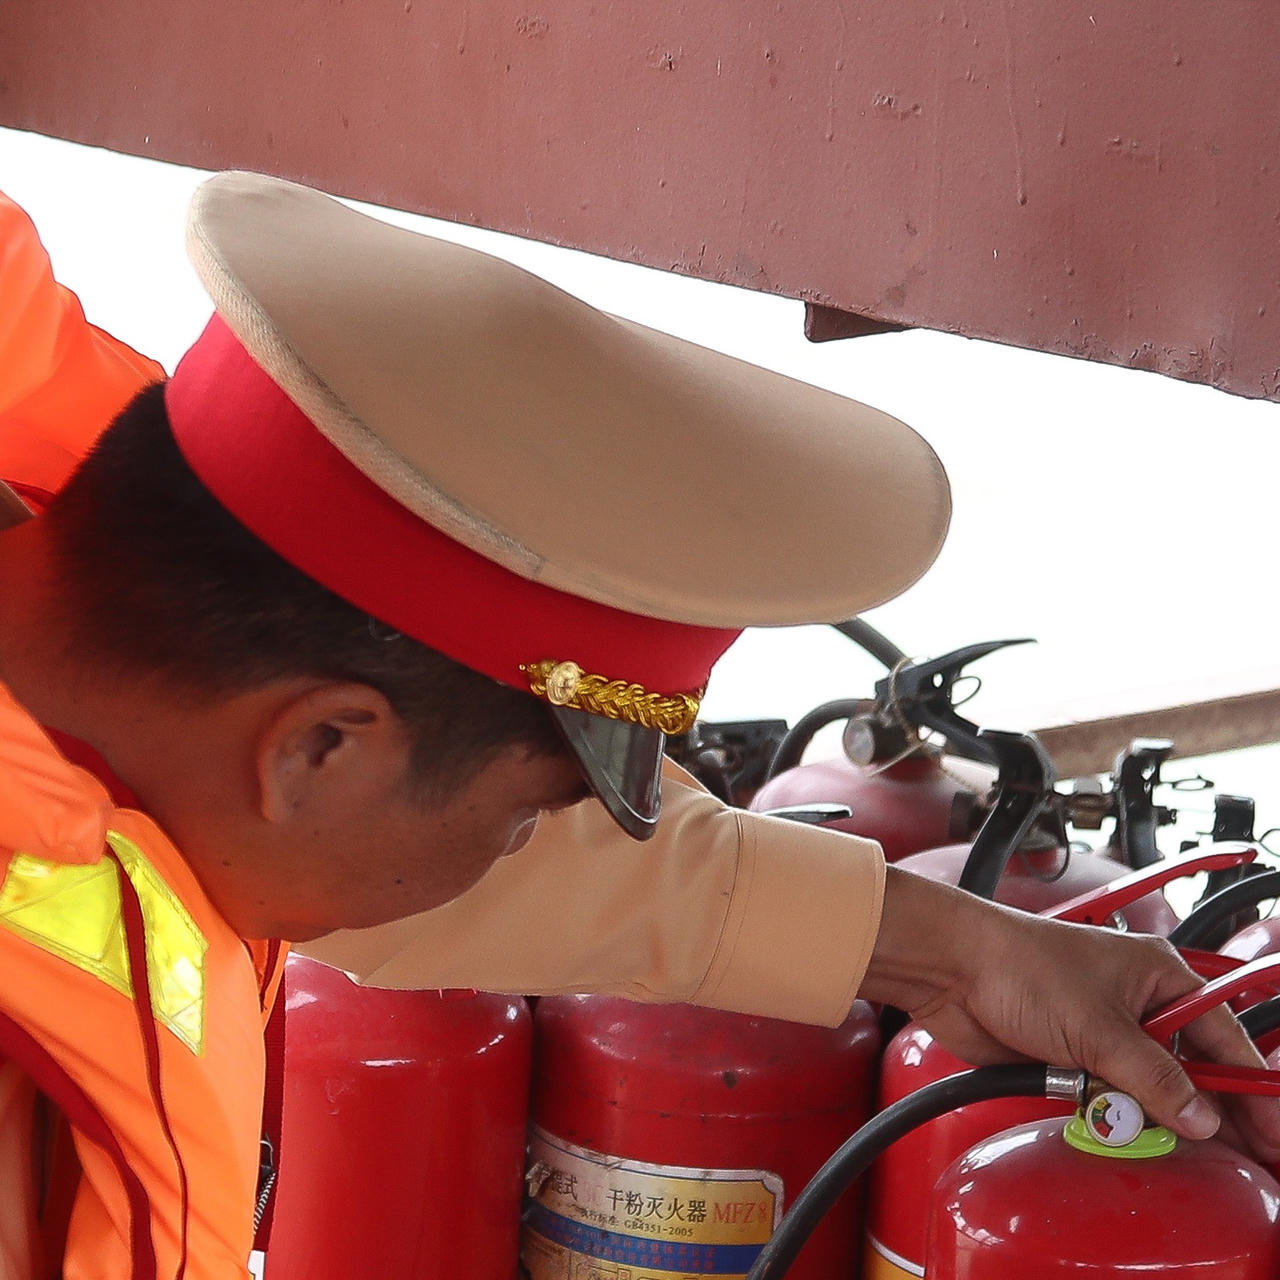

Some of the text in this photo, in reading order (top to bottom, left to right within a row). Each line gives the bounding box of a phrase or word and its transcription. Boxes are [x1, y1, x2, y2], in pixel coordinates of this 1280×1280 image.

[606, 1187, 708, 1224] 干粉灭火器
